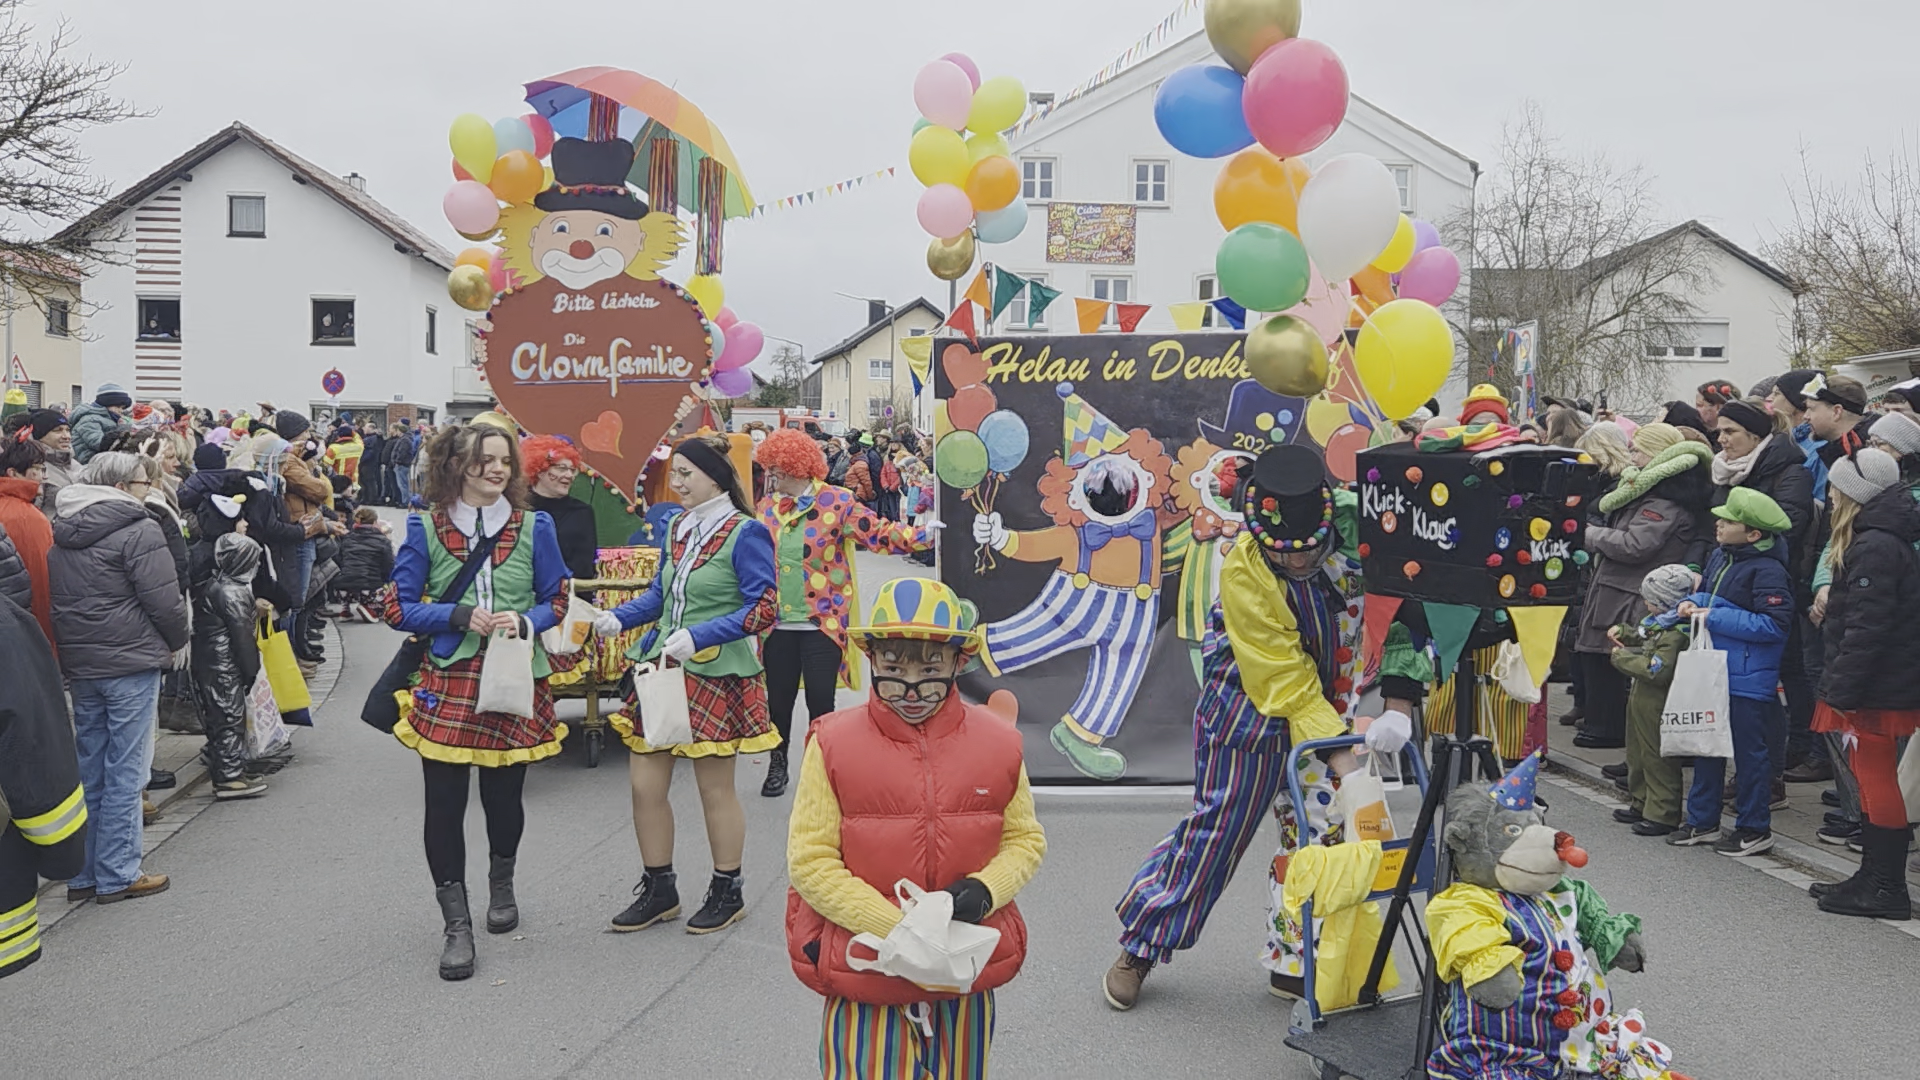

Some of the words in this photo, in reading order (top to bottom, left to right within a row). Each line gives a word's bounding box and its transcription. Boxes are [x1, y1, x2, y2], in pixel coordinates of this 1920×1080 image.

[552, 292, 596, 314] Bitte
[563, 333, 586, 346] Die
[511, 337, 694, 398] Clownfamilie
[982, 342, 1091, 384] Helau
[1102, 350, 1137, 381] in
[1359, 824, 1380, 833] Haag
